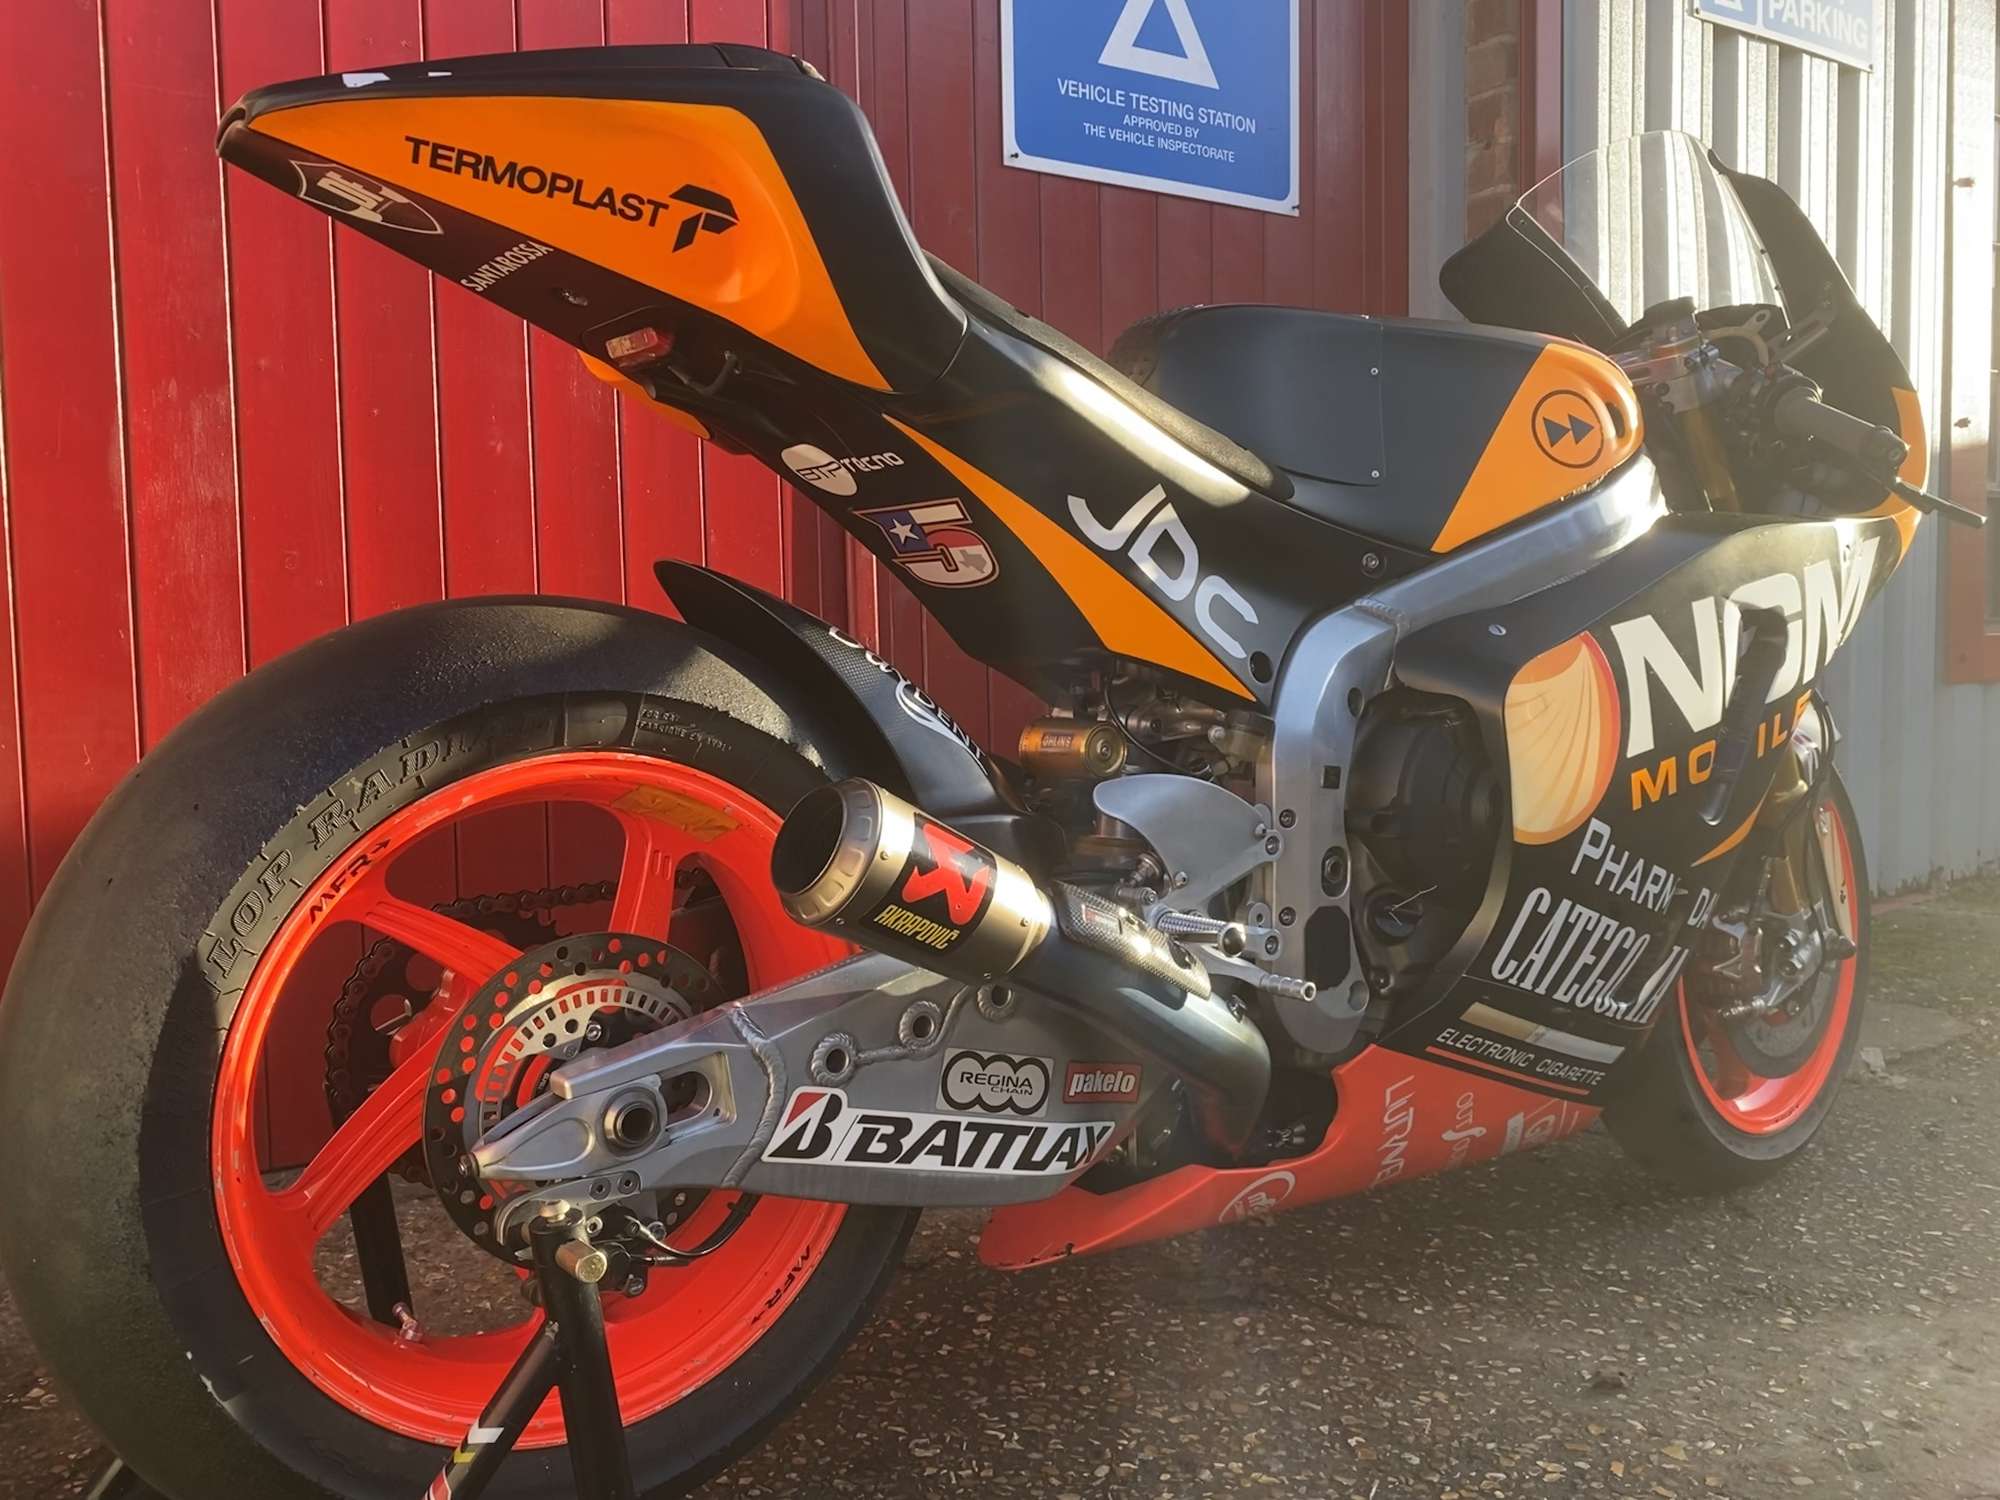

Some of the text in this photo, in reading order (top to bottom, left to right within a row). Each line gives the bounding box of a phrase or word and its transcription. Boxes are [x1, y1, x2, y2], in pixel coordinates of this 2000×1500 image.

[1768, 0, 1869, 49] PARKING
[1057, 77, 1256, 134] VEHICLE TESTING STATION
[1123, 114, 1200, 140] APPROVED BY
[1083, 122, 1236, 163] THE VEHICLE INSPECTORATE
[404, 135, 669, 228] TERMOPLAST
[460, 240, 553, 293] SANTAROSSA
[850, 497, 1000, 588] 5
[1067, 483, 1260, 660] JDC
[1631, 689, 1813, 811] MOILE
[959, 1071, 1034, 1090] REGINA
[1069, 1069, 1137, 1097] pakelo
[1436, 1027, 1606, 1087] ELECTRONIC CIGARETTE
[990, 1086, 1034, 1097] CHAIN
[844, 1113, 1112, 1171] BATTLAX
